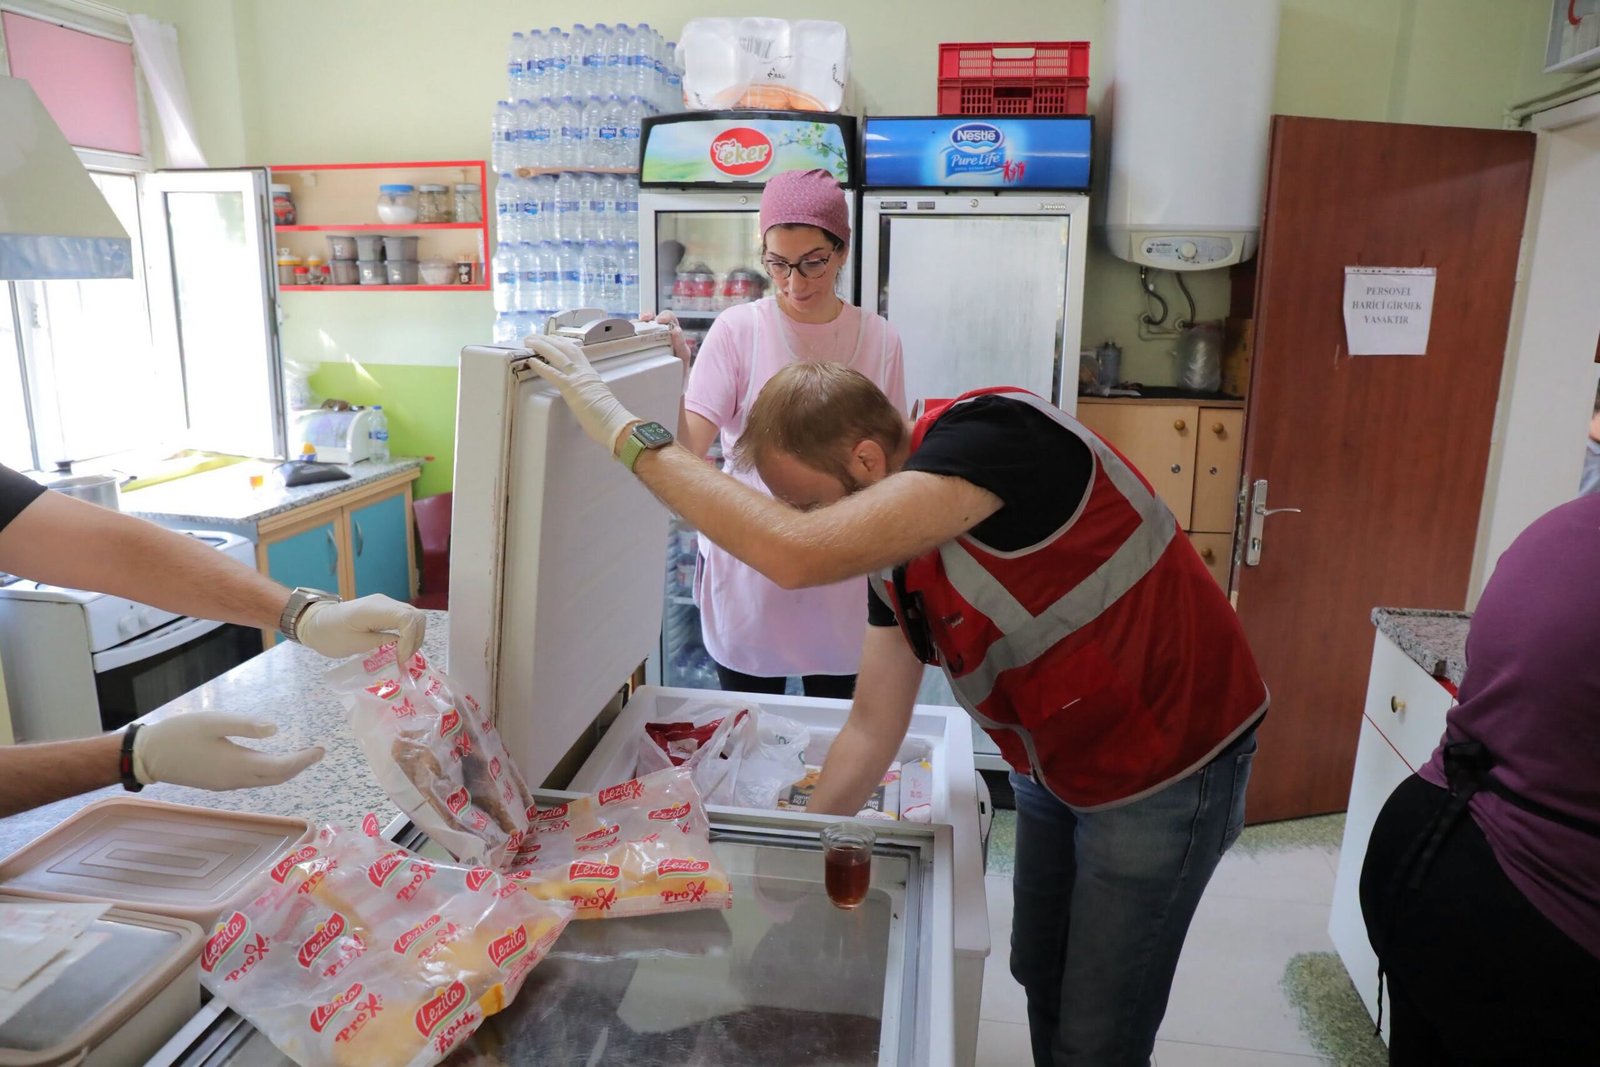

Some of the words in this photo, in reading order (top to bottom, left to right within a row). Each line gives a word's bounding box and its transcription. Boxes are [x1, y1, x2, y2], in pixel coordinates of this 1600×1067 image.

[951, 154, 978, 167] Pure
[979, 152, 1000, 166] Life
[1366, 286, 1411, 296] PERSONEL
[1364, 315, 1409, 324] YASAKTIR
[275, 848, 315, 879] Lezita
[573, 863, 615, 876] Lezita
[661, 860, 705, 872] Lezita
[205, 918, 242, 967] Lezita
[302, 919, 341, 962] Lezita
[493, 929, 526, 964] Lezita
[315, 986, 362, 1026] Lezita
[421, 987, 462, 1030] Lezita
